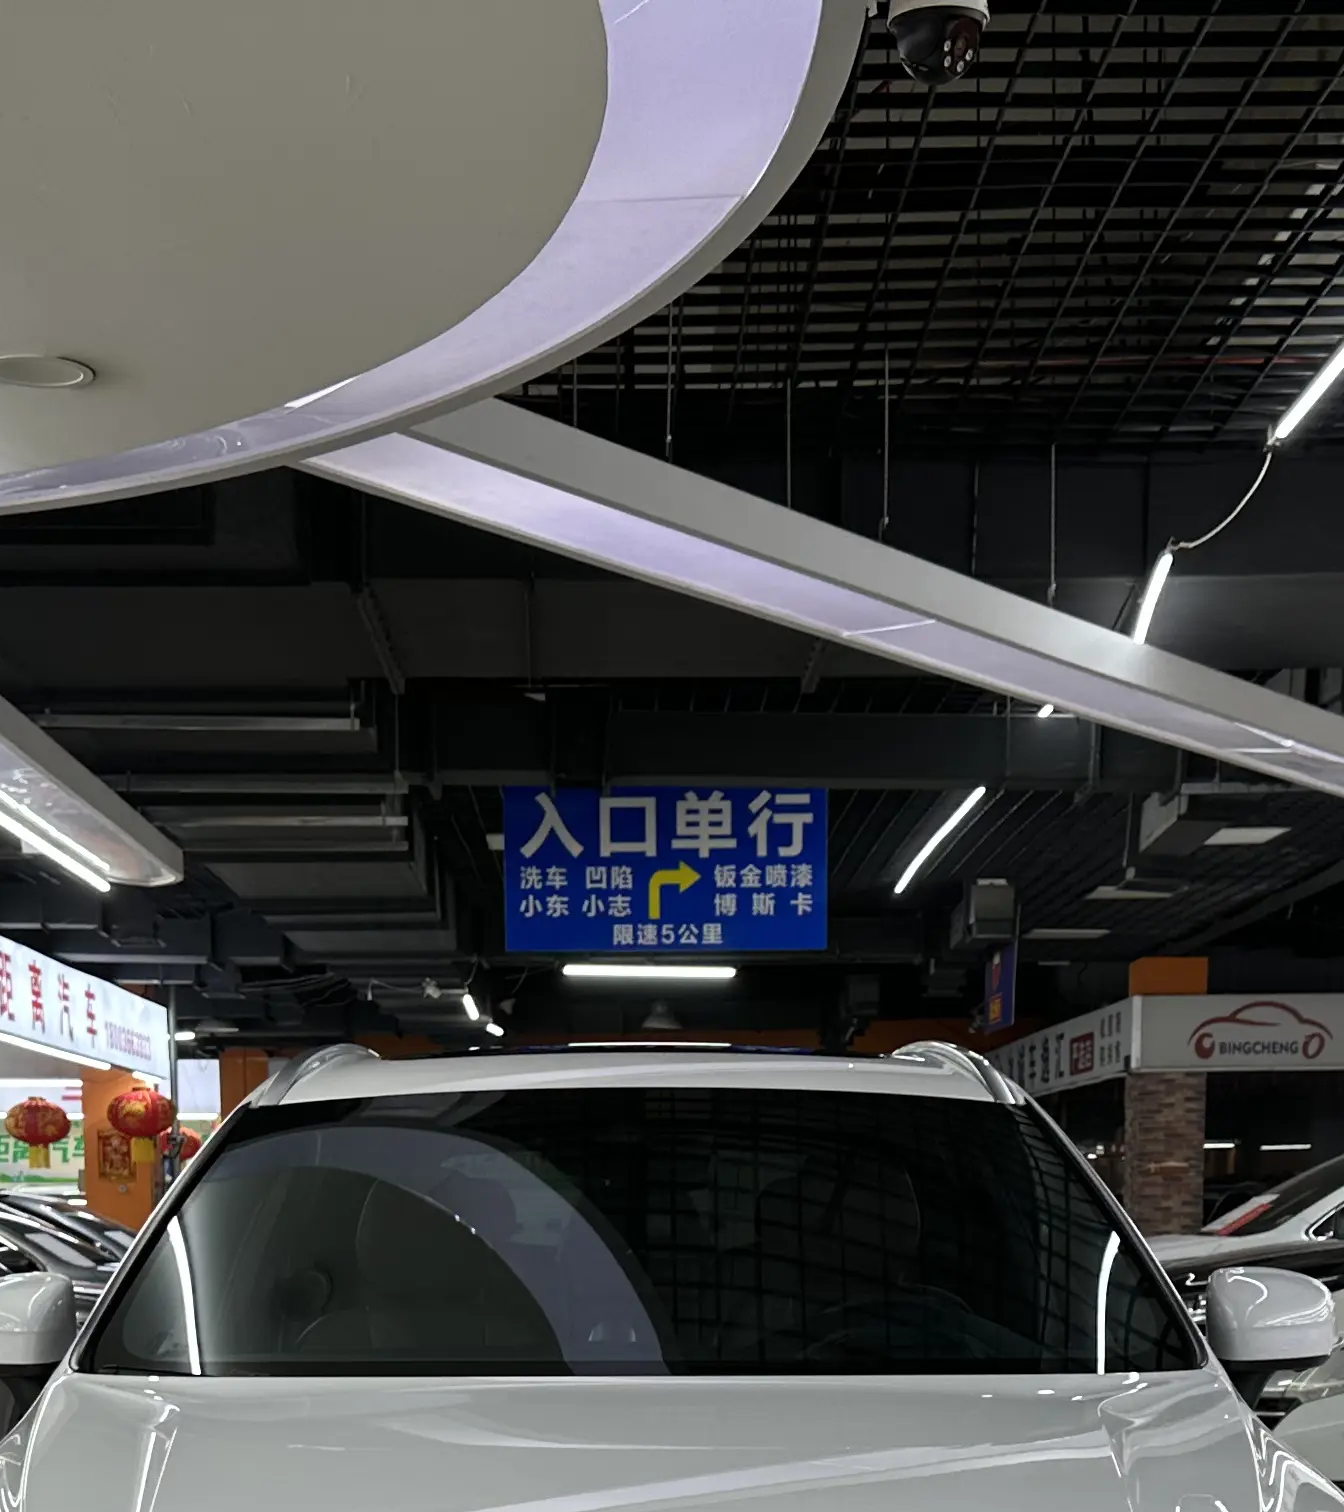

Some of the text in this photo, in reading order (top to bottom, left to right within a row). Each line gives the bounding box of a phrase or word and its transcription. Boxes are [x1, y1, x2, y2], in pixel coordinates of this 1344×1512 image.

[519, 789, 814, 859] 入口单行
[520, 865, 633, 890] 洗车 凹陷
[713, 864, 814, 889] 钣金喷漆
[519, 894, 632, 918] 小东 小志
[713, 893, 814, 917] 博斯卡
[612, 923, 724, 945] 限速5公里
[1218, 1041, 1300, 1056] BINGCHENG
